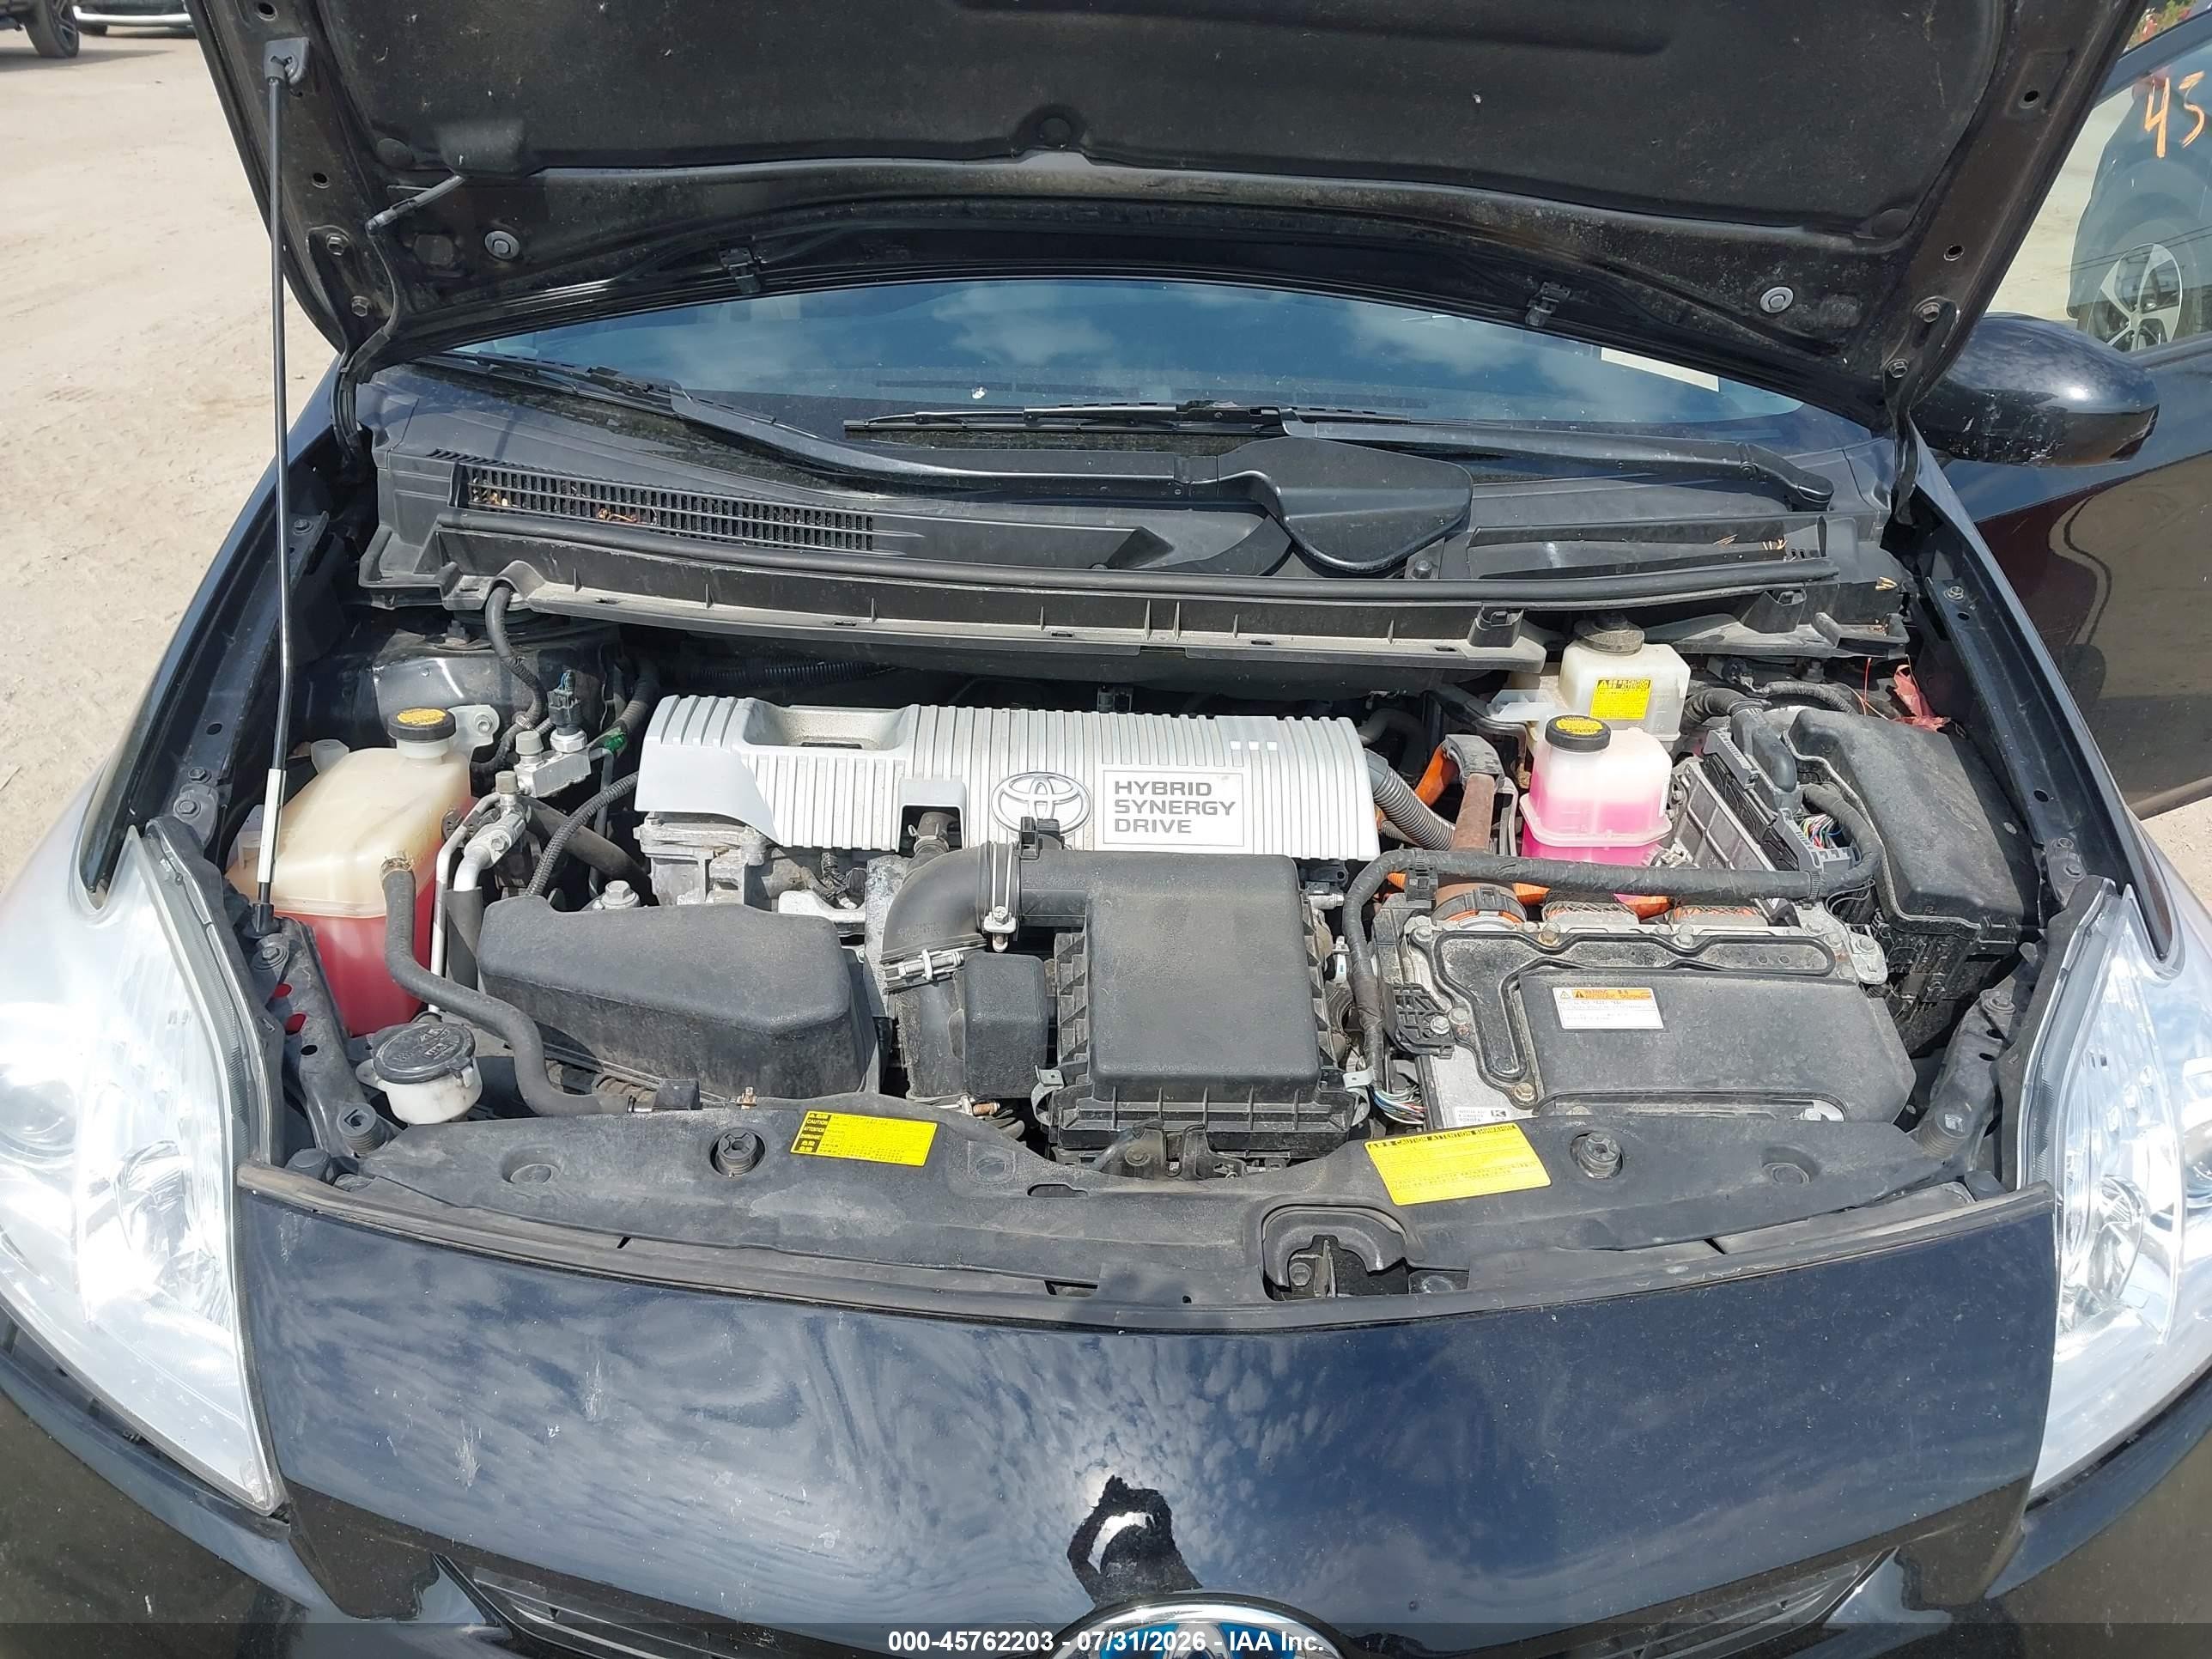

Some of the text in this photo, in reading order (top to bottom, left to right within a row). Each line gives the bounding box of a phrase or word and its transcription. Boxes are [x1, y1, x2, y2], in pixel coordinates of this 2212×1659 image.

[1115, 781, 1212, 796] HYBRID
[1115, 799, 1236, 816] SYNERGY
[1115, 818, 1192, 833] DRIVE
[1395, 1135, 1428, 1146] CAUTION
[1431, 1130, 1472, 1140] ATTENTION
